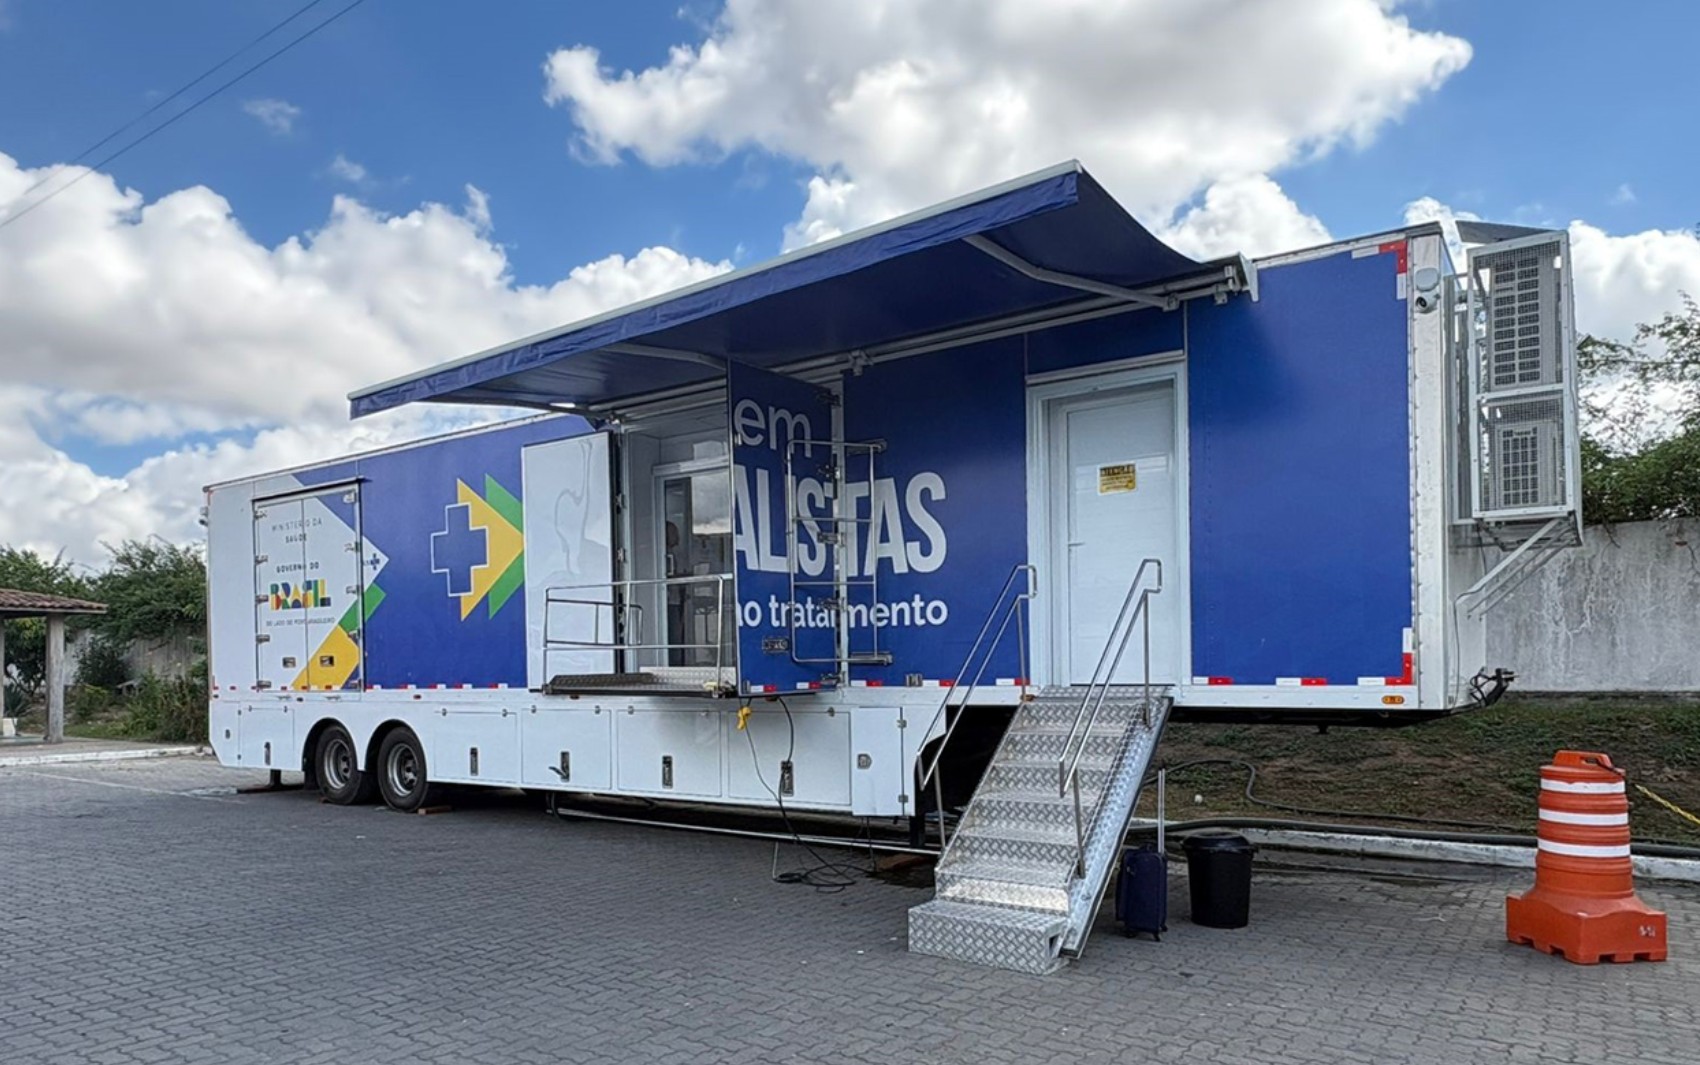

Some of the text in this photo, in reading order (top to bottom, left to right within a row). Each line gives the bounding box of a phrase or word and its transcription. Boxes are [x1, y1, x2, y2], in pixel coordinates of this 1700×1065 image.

[734, 398, 812, 458] em
[733, 464, 947, 577] ALISTAS
[270, 579, 332, 611] BRASIL
[768, 594, 948, 628] tratamento
